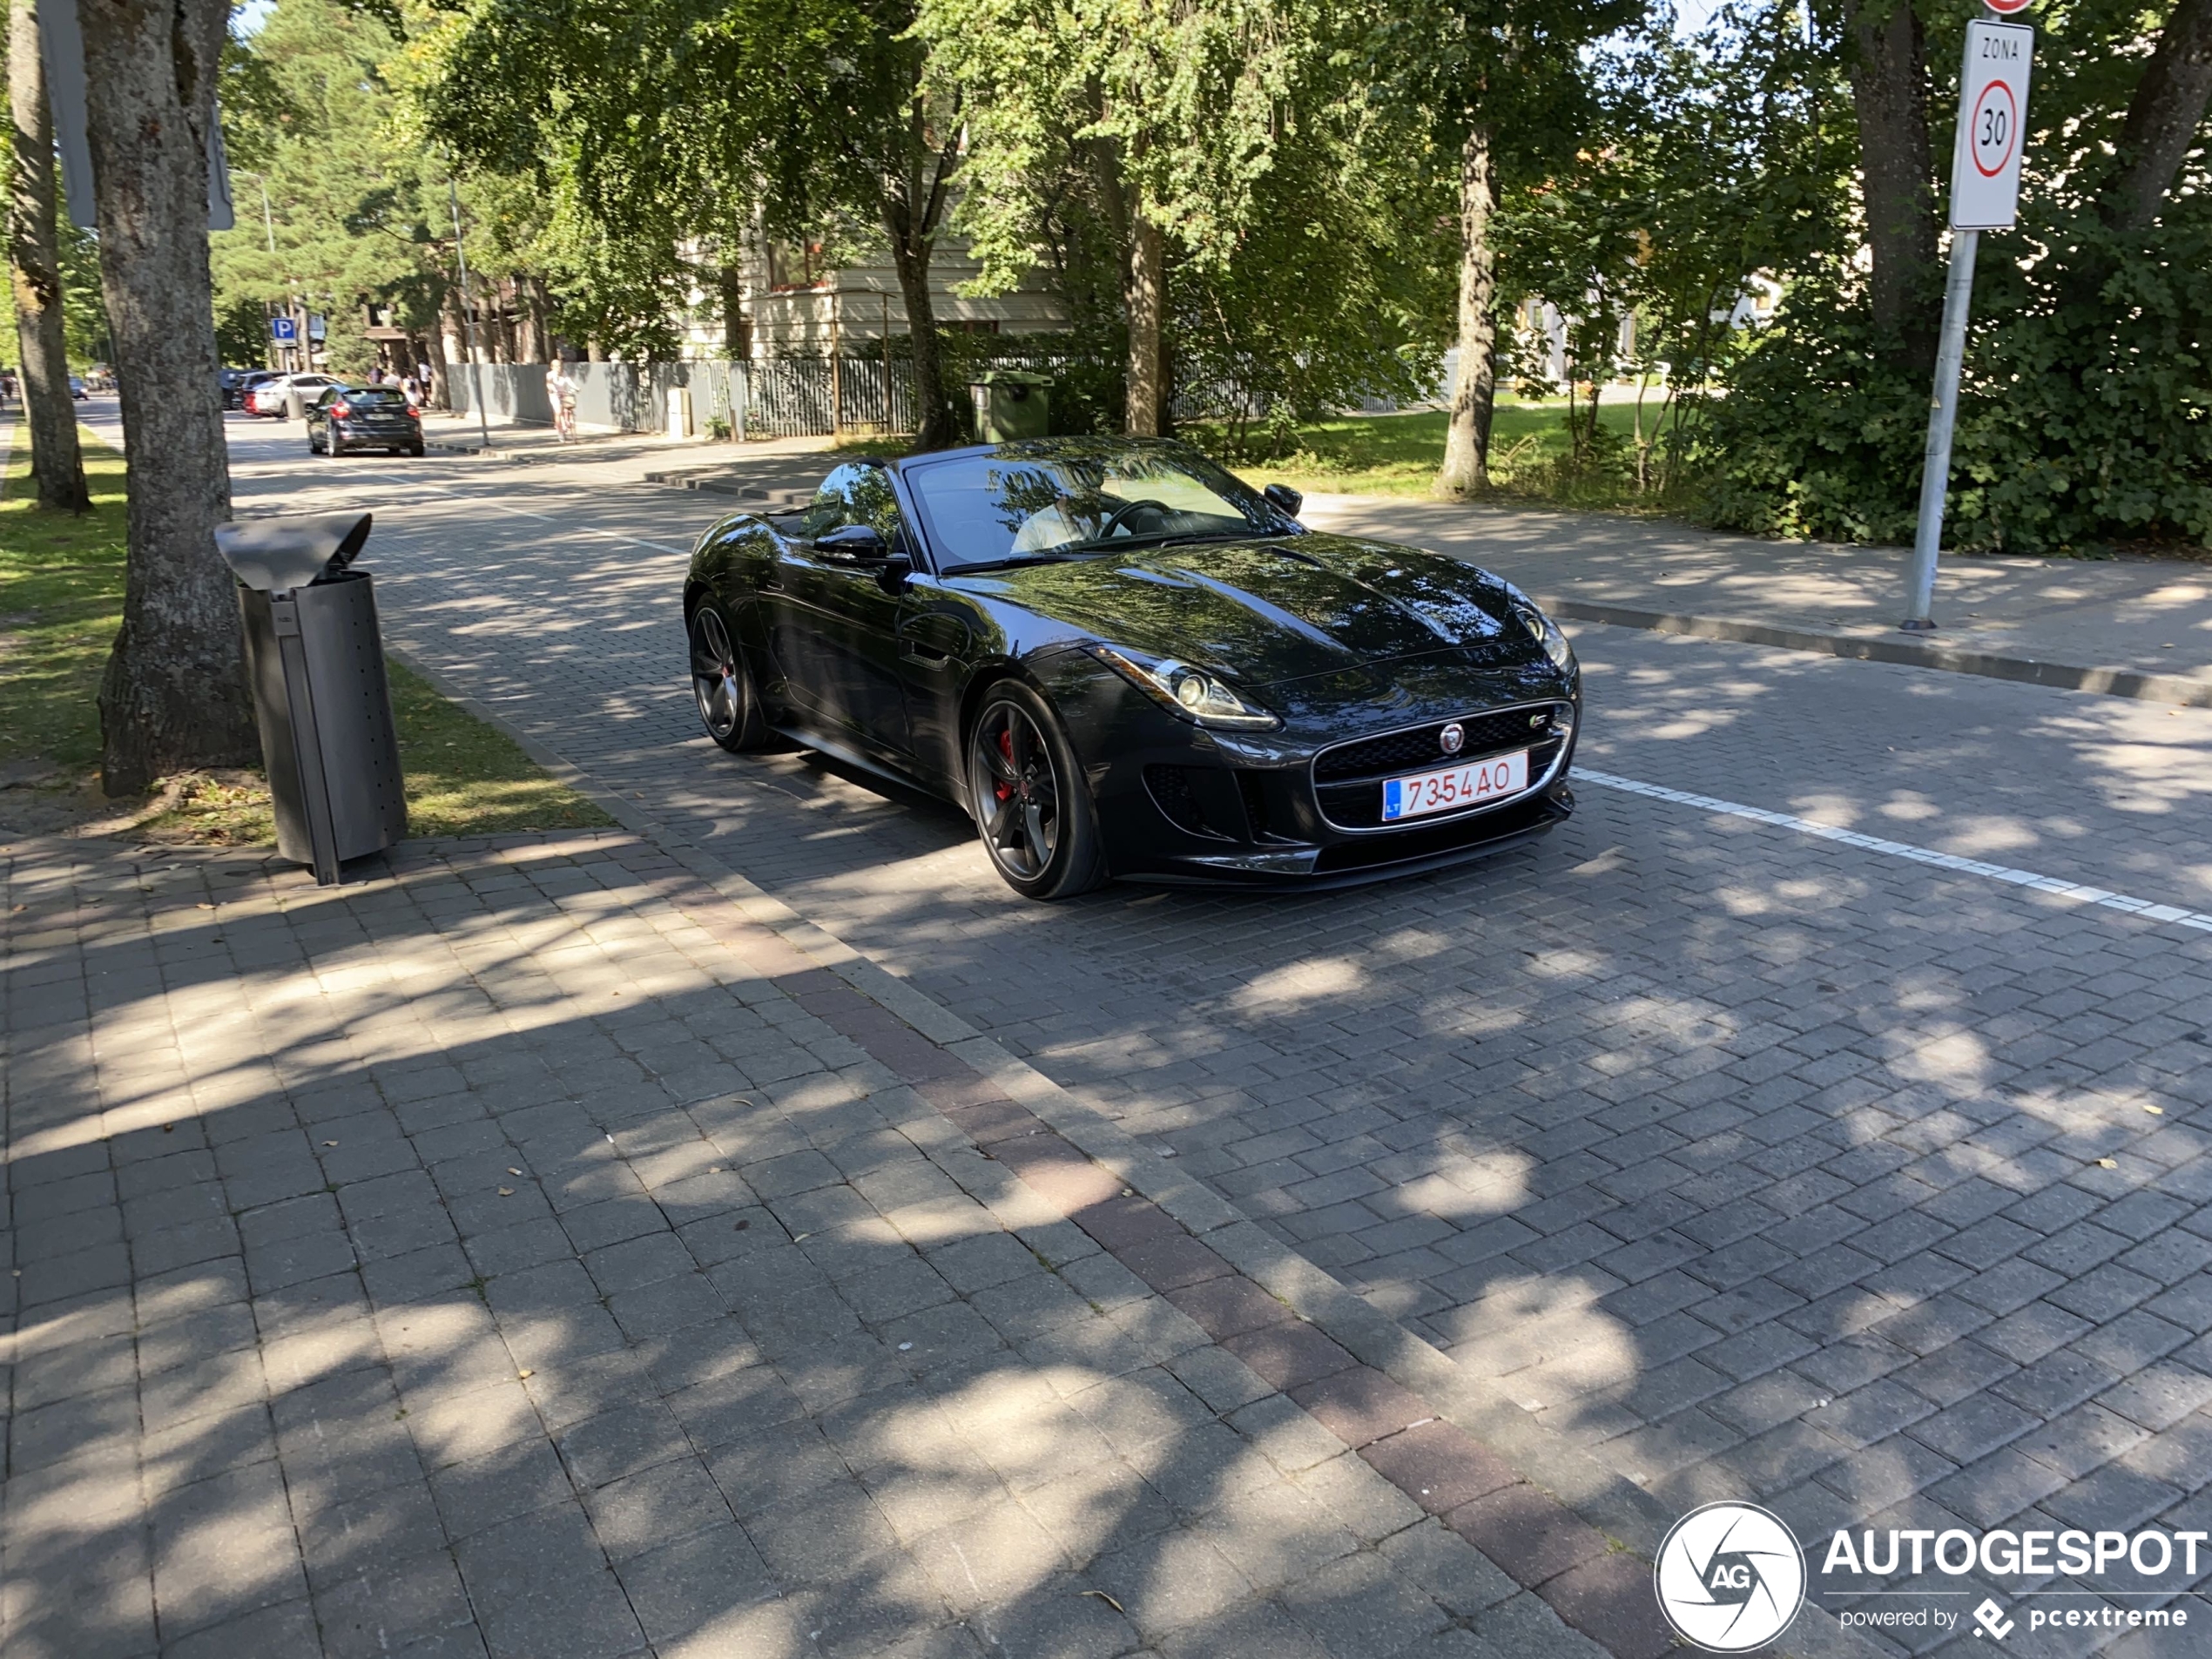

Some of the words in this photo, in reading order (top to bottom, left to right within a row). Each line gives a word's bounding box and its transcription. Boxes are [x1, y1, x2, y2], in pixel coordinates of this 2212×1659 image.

[1982, 37, 2019, 61] ZONA
[1981, 108, 2006, 146] 30
[278, 320, 292, 337] P
[1386, 803, 1399, 813] LT
[1408, 762, 1509, 811] 7354AO
